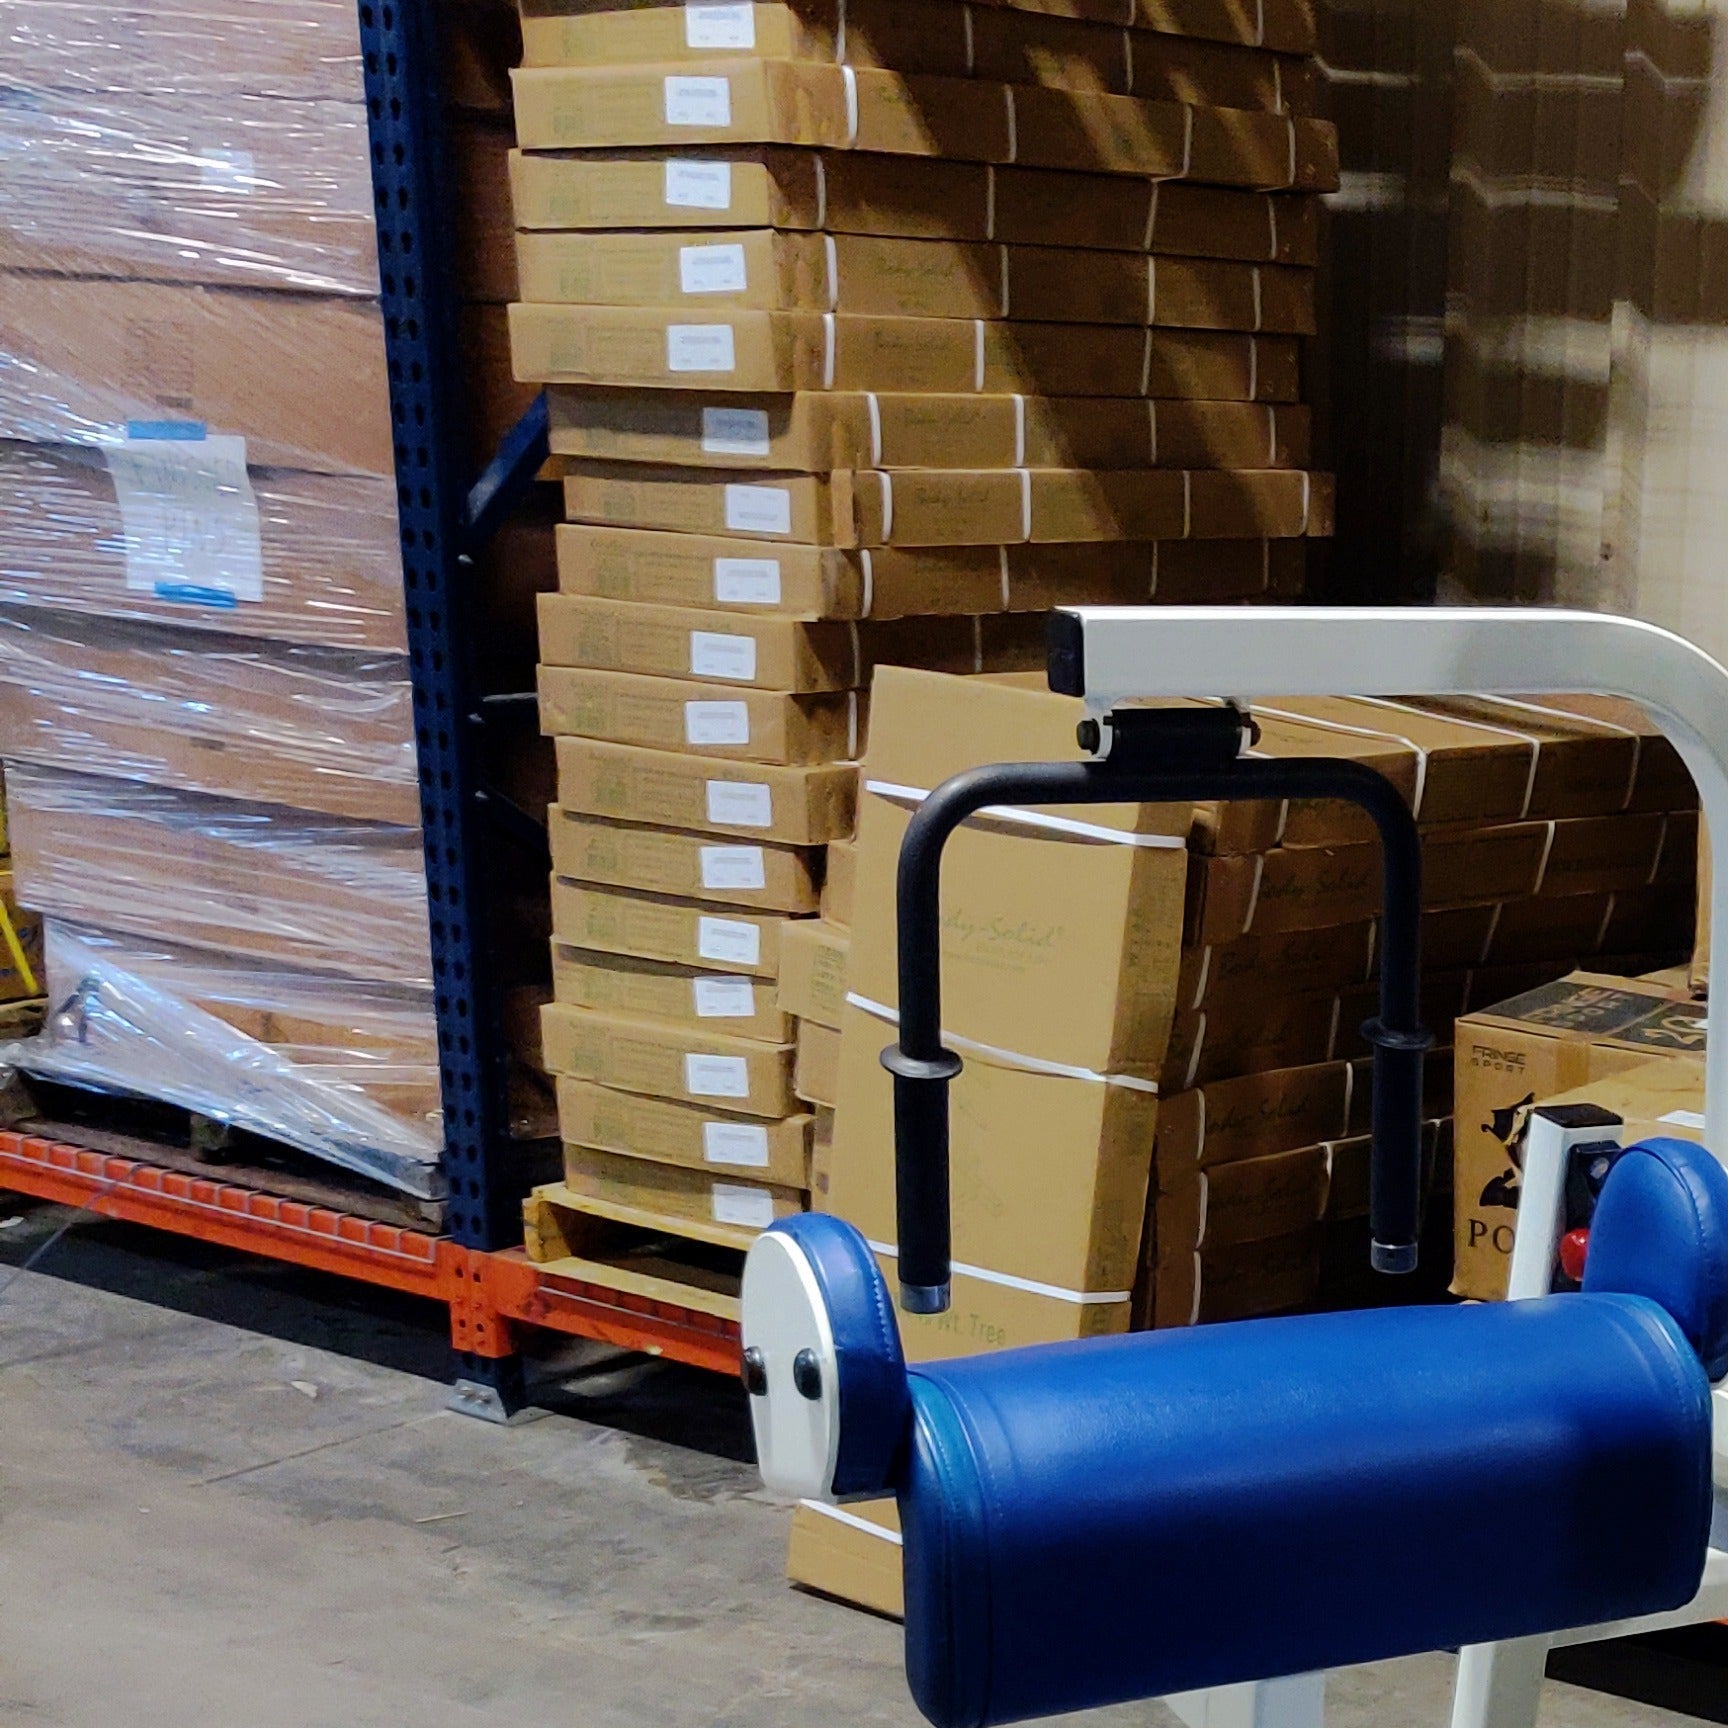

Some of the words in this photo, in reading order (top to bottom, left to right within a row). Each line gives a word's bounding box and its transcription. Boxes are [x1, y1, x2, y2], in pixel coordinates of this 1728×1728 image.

[1471, 1044, 1527, 1066] FRINGE
[1467, 1218, 1515, 1254] PO
[969, 1312, 1007, 1346] Tree
